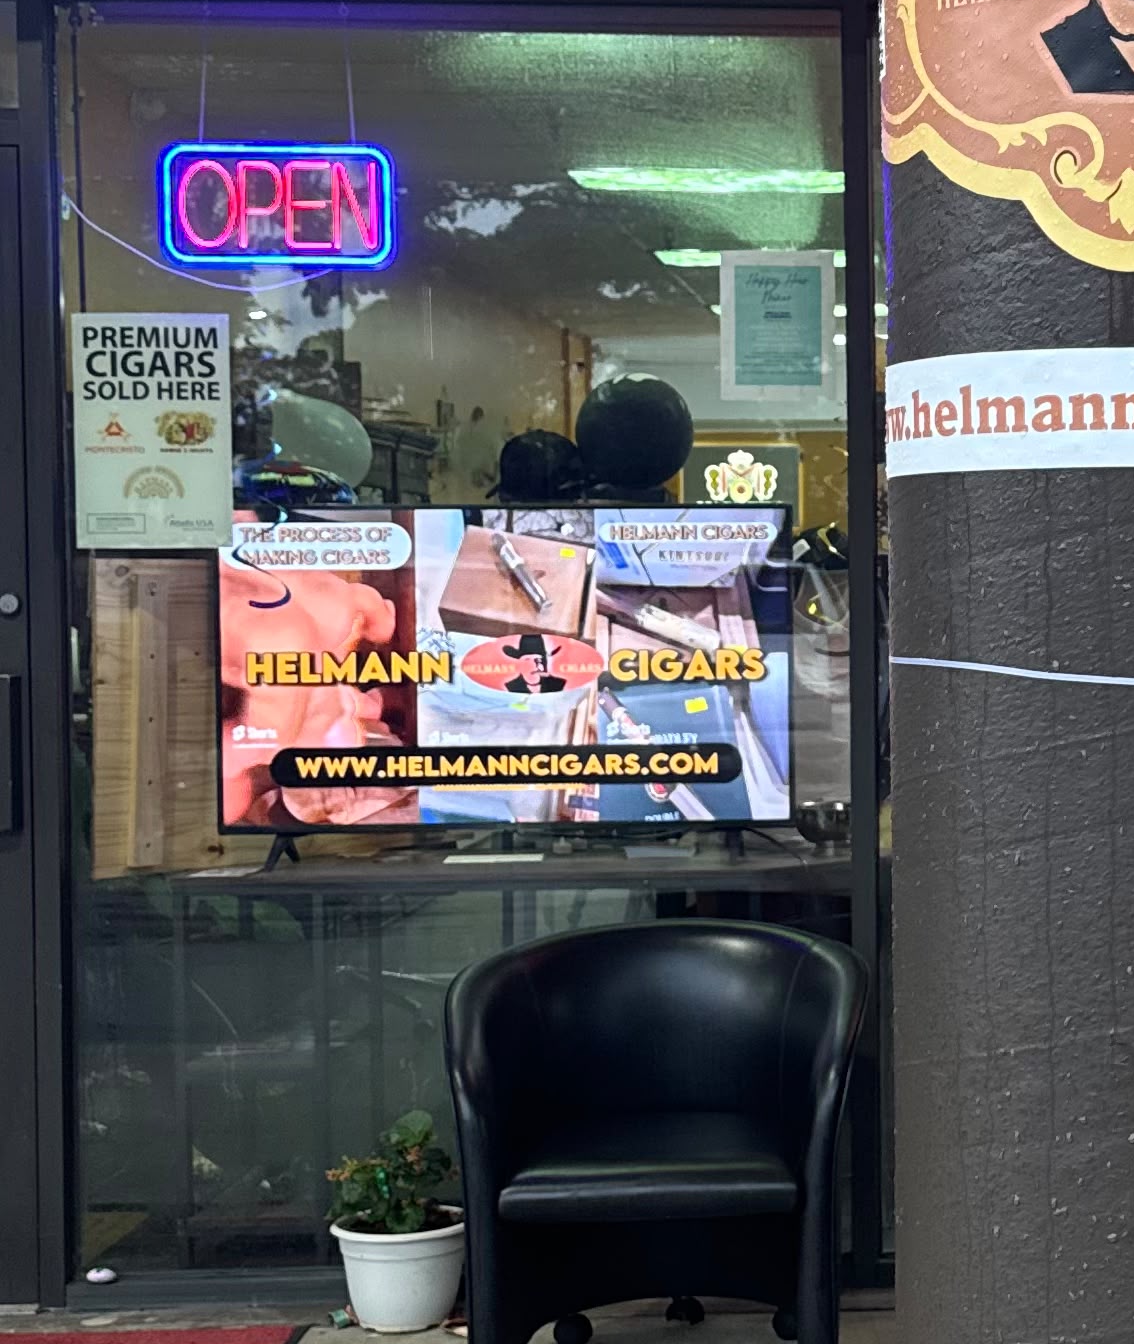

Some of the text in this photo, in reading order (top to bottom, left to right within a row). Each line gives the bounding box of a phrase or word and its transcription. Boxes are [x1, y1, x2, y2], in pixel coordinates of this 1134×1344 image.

[178, 159, 378, 250] OPEN
[82, 326, 219, 349] PREMIUM
[85, 350, 217, 379] CIGARS
[83, 381, 222, 401] SOLD HERE
[239, 526, 393, 543] THE PROCESS OF
[609, 524, 770, 541] HELMANN CIGARS
[242, 549, 392, 565] MAKING CIGARS
[246, 648, 769, 686] HELMANN CIGARS
[295, 751, 719, 779] WWW.HELMANNCIGARS.COM
